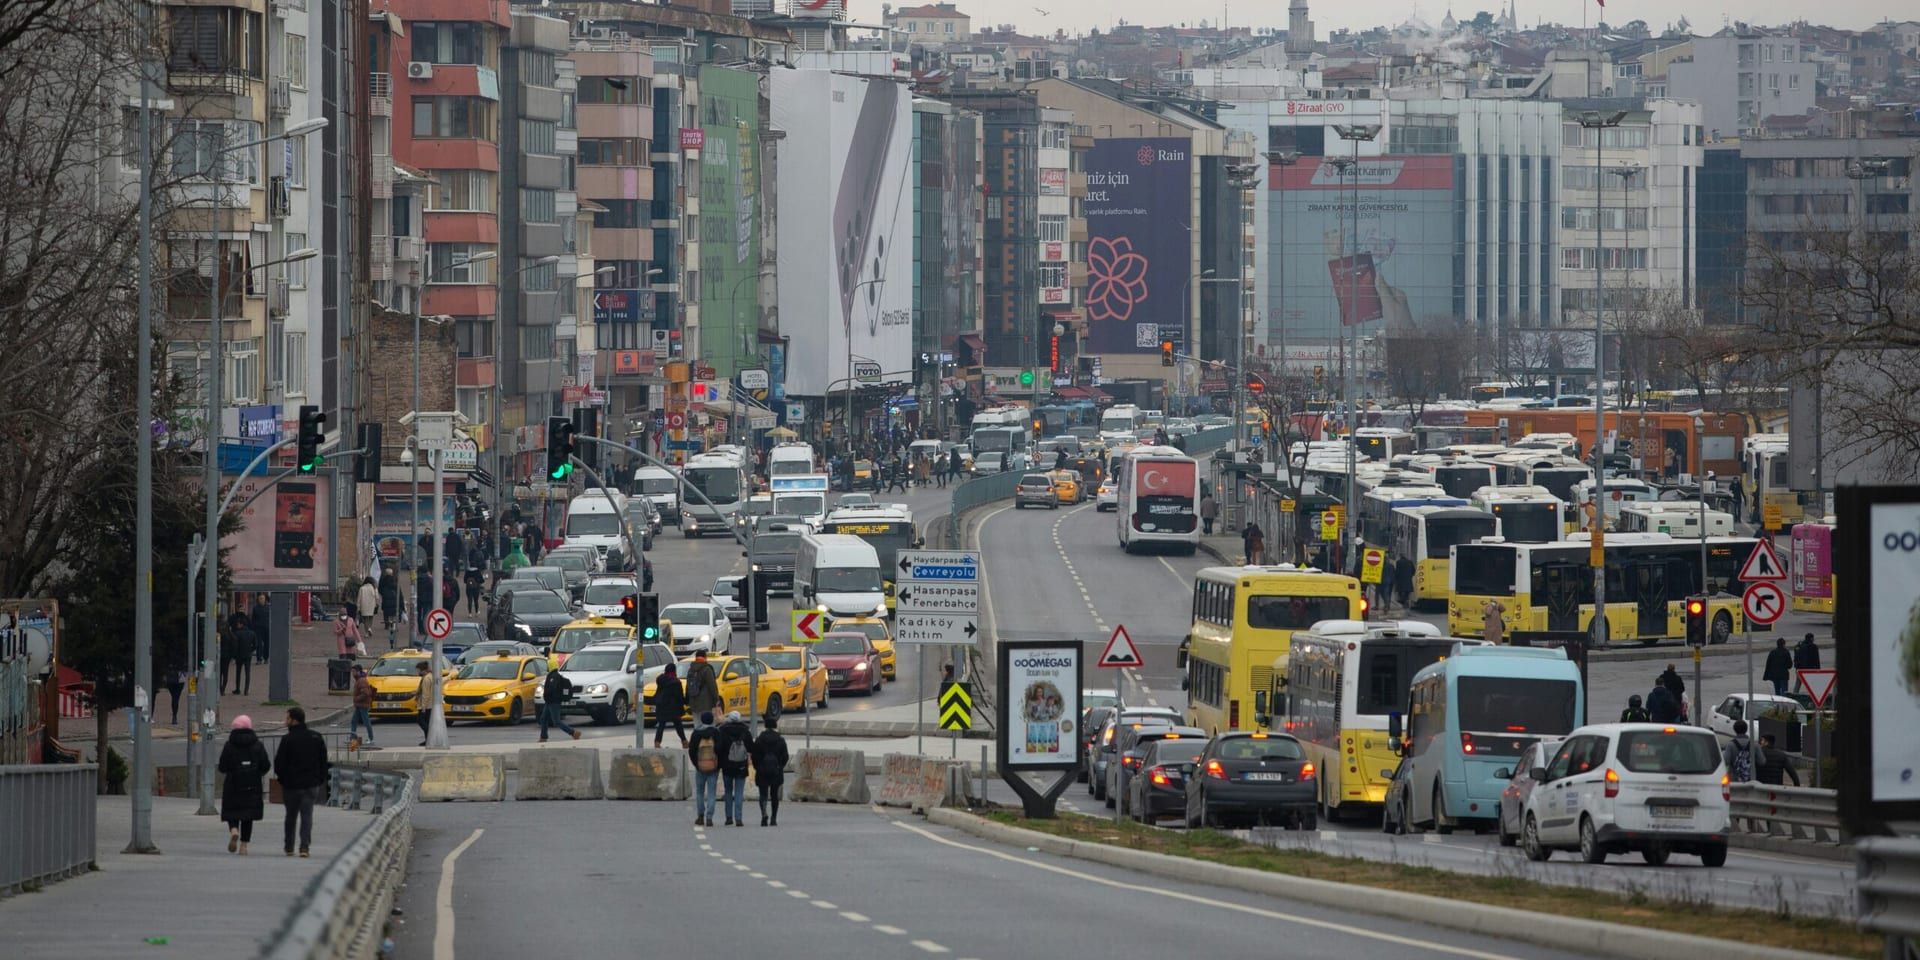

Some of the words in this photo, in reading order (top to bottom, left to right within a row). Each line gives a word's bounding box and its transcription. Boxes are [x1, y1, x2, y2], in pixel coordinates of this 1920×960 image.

[1298, 103, 1322, 112] Ziraat
[1326, 103, 1344, 112] GYO
[1158, 149, 1184, 160] Rain
[1336, 167, 1363, 176] Zrat
[1084, 171, 1105, 185] niz
[1108, 171, 1129, 188] için
[856, 368, 880, 376] FOTO
[453, 442, 475, 450] NYA
[913, 566, 976, 578] Çevreyolu
[913, 585, 977, 597] Hasanpaşa
[913, 598, 976, 609] Fenerbahçe
[899, 617, 953, 629] Kadıköy
[899, 630, 943, 639] Rıhtım
